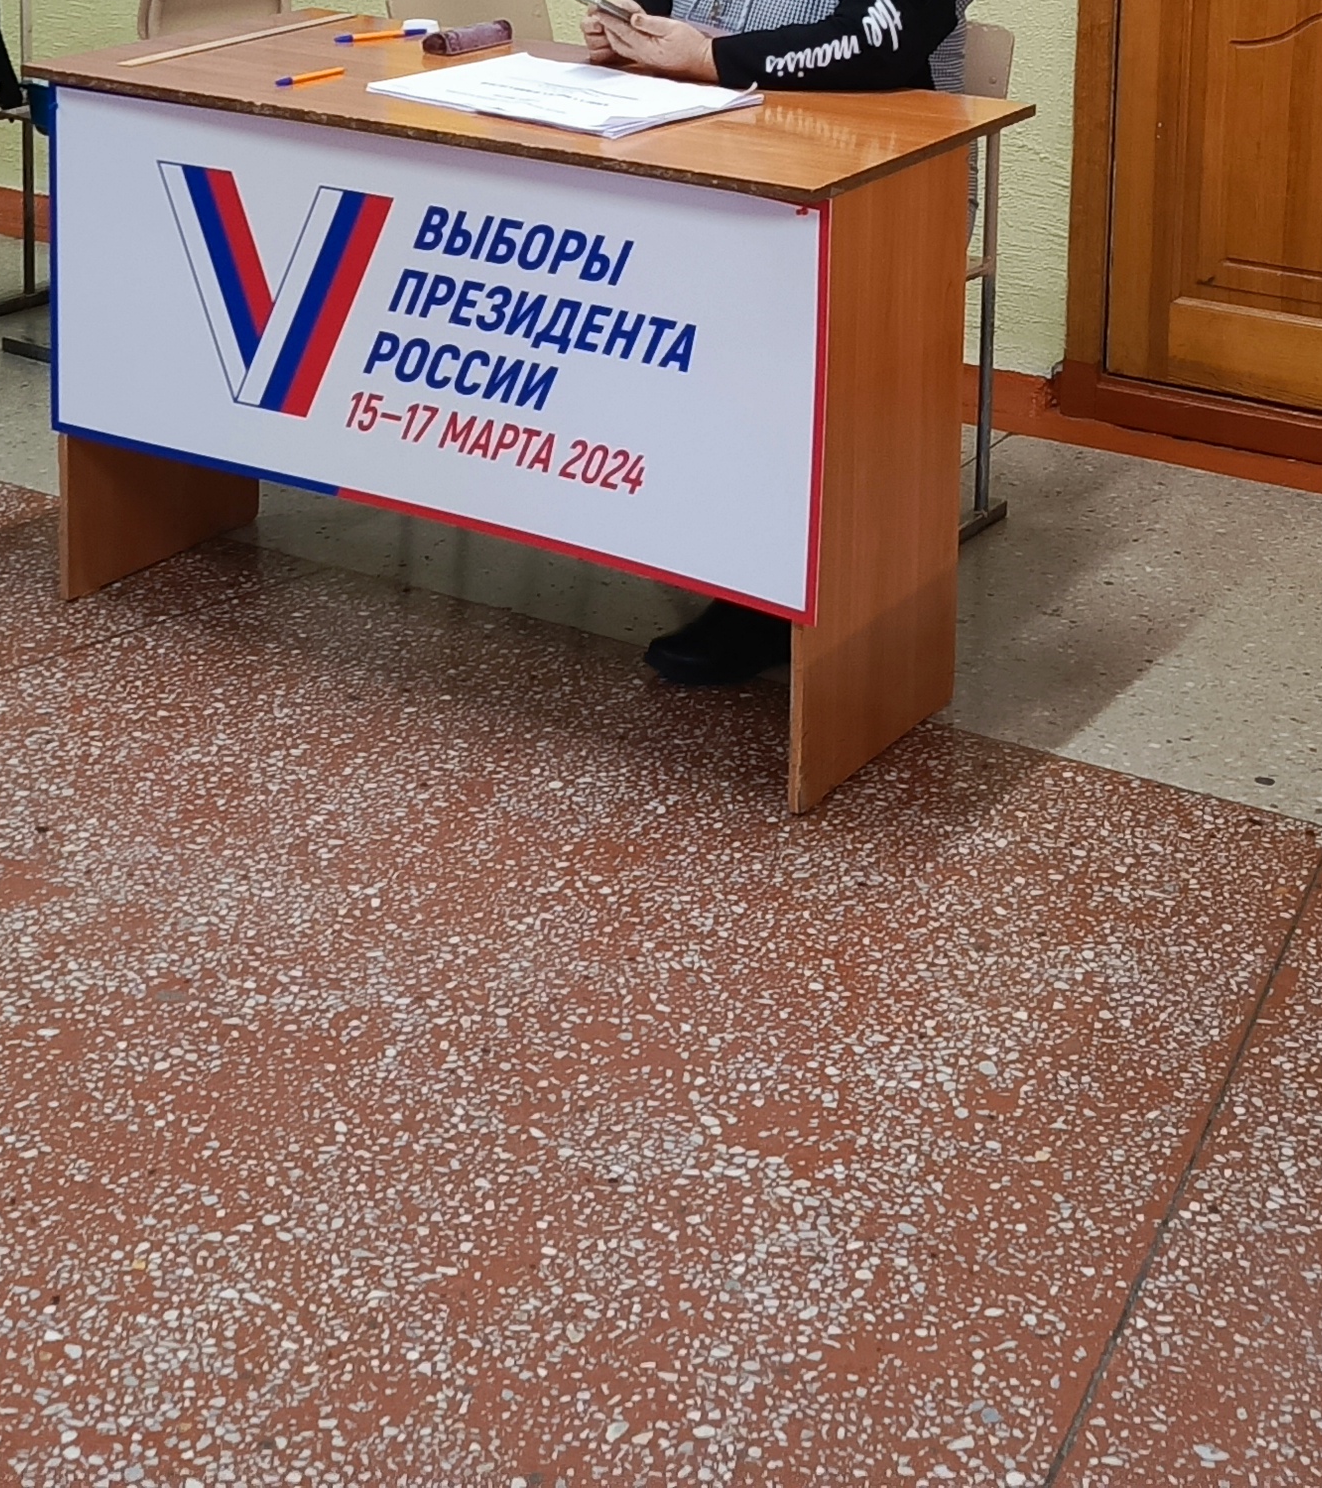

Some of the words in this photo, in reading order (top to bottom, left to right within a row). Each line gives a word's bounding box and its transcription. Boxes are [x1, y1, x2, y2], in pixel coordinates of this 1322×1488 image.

[413, 204, 635, 287] ВЫБОРЫ
[388, 268, 698, 374] ПРЕЗИДЕНТА
[363, 330, 559, 412] РОССИИ
[438, 410, 556, 473] МАРТА
[558, 438, 645, 496] 2024
